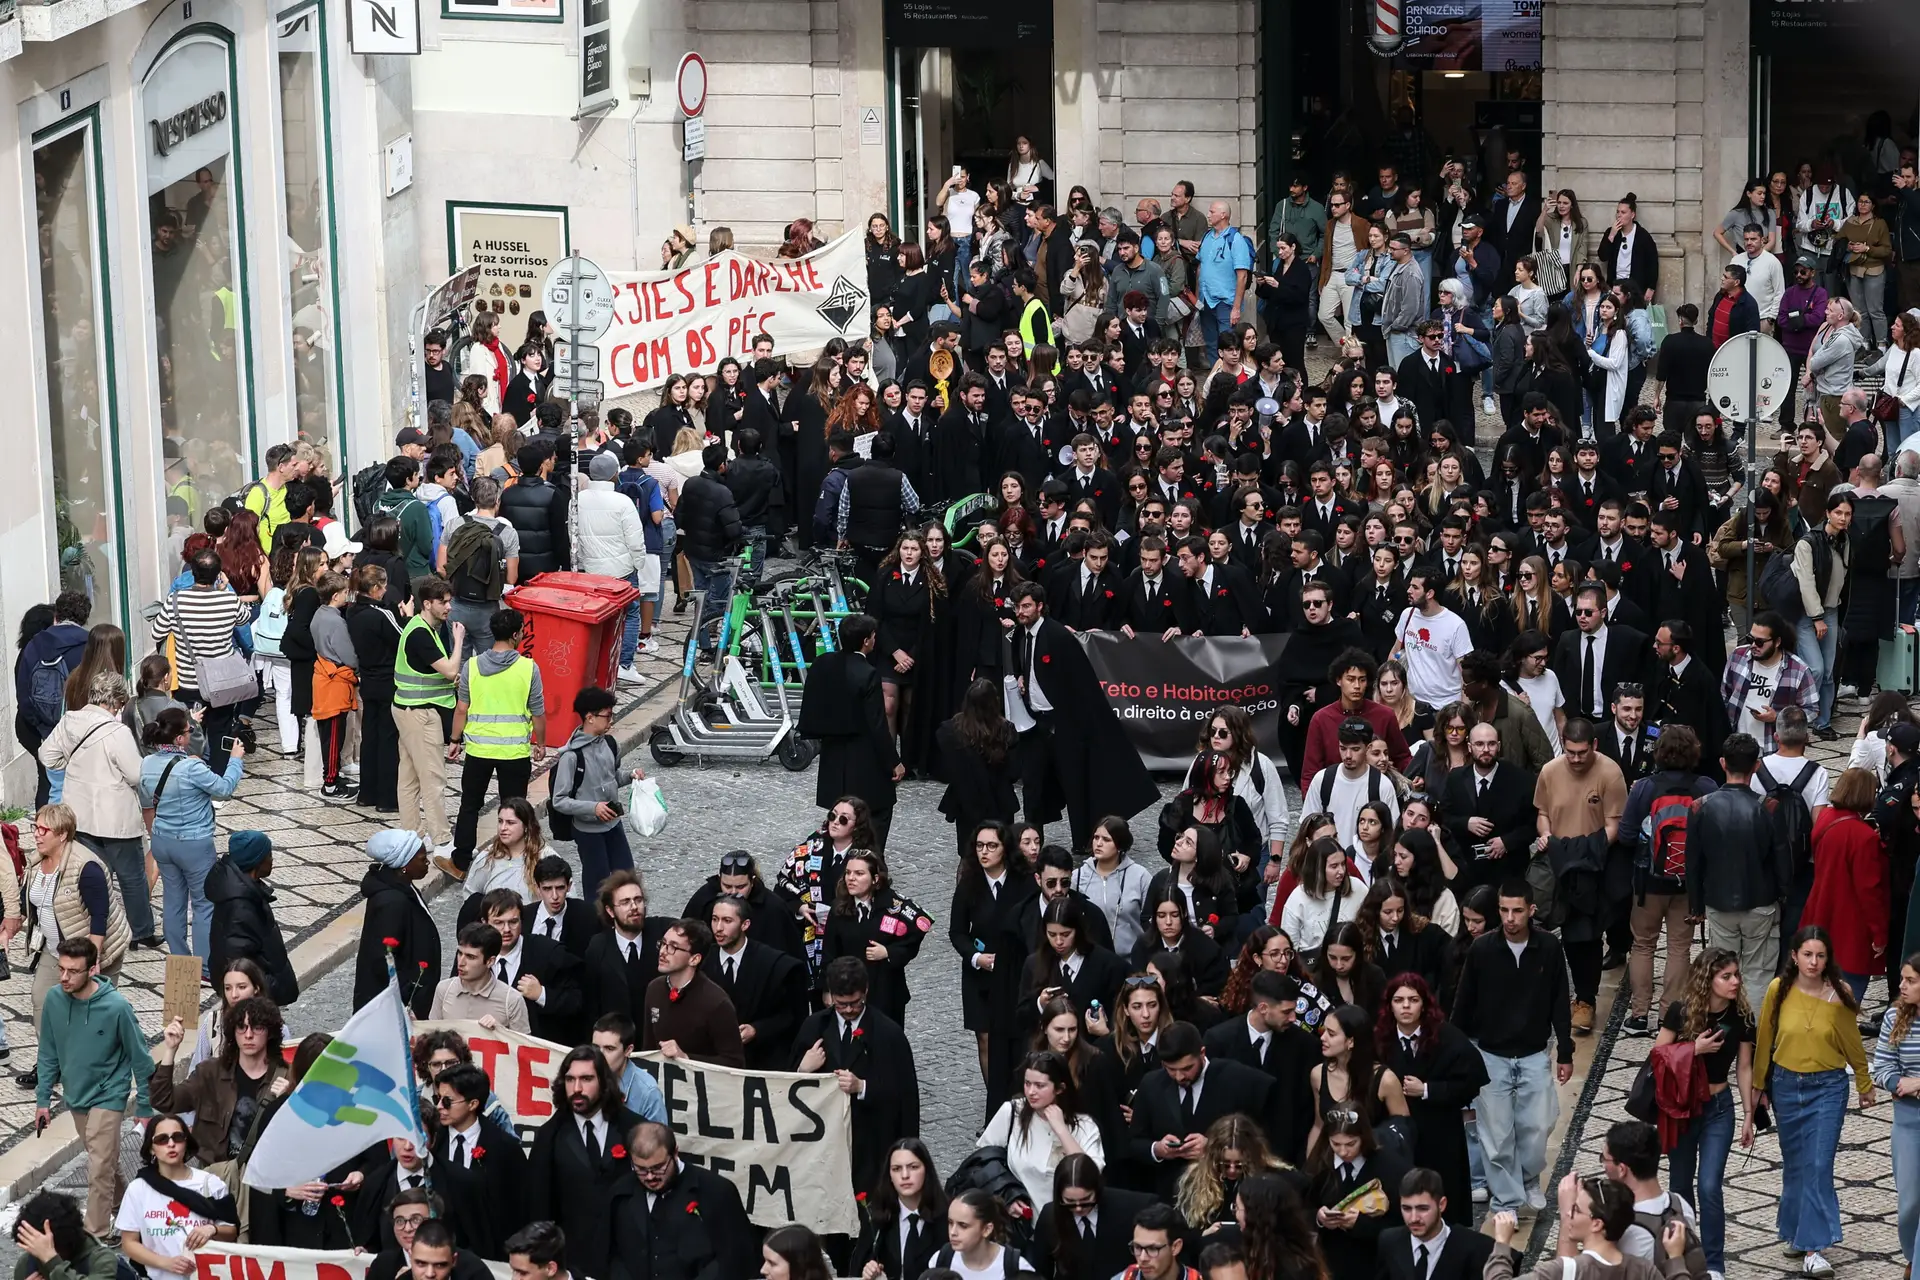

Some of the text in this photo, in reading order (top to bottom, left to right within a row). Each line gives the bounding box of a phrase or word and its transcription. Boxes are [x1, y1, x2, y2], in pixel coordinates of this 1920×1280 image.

[914, 3, 932, 11] Lojas
[1406, 5, 1464, 15] ARMAZÉNS
[1406, 16, 1422, 25] DO
[1782, 11, 1801, 19] Lojas
[1406, 26, 1448, 35] CHIADO
[1502, 30, 1541, 38] women'
[149, 91, 227, 157] NESPRESSO
[472, 240, 531, 252] A HUSSEL
[473, 253, 548, 266] traz sorrisos
[484, 267, 538, 279] esta rua.
[704, 262, 721, 308] E
[729, 256, 824, 301] DAR-LHE
[611, 306, 776, 388] COM OS PÉS
[823, 632, 832, 650] BIR
[790, 638, 802, 664] BIRD
[771, 650, 782, 682] BIRD
[1099, 681, 1273, 703] Teto e Habitação.
[1757, 686, 1771, 698] DO
[1124, 704, 1176, 719] direito
[1180, 706, 1191, 720] à
[627, 1057, 826, 1144] ELAS
[144, 1210, 169, 1219] ABRIL
